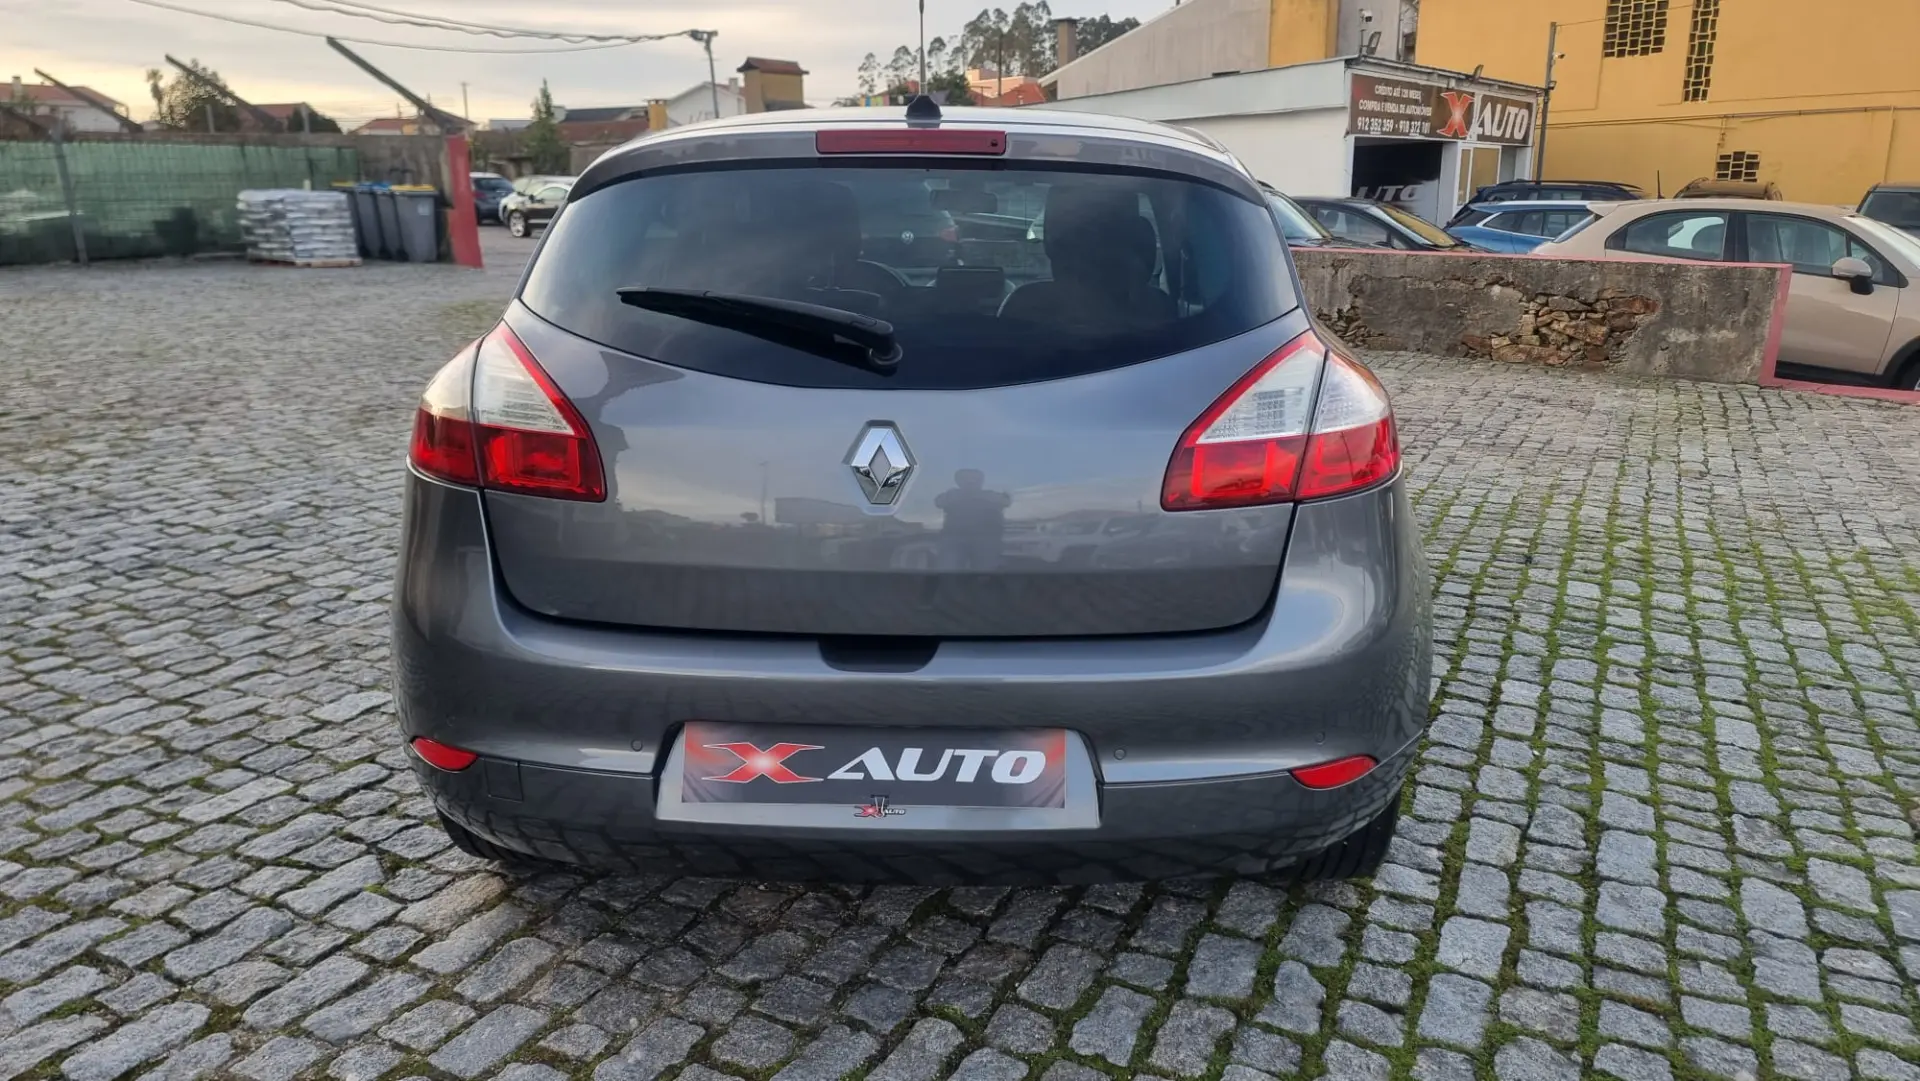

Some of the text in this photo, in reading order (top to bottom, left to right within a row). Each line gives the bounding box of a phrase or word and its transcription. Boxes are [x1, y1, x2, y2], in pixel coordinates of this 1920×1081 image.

[1359, 100, 1381, 112] COMPRA
[1385, 102, 1399, 114] VENDA
[1400, 104, 1405, 114] DE
[1437, 92, 1529, 140] X AUTO
[1357, 117, 1369, 131] 912
[1370, 118, 1382, 132] 352
[1382, 118, 1394, 132] 359
[702, 742, 1046, 784] X AUTO
[884, 808, 906, 816] AUTO
